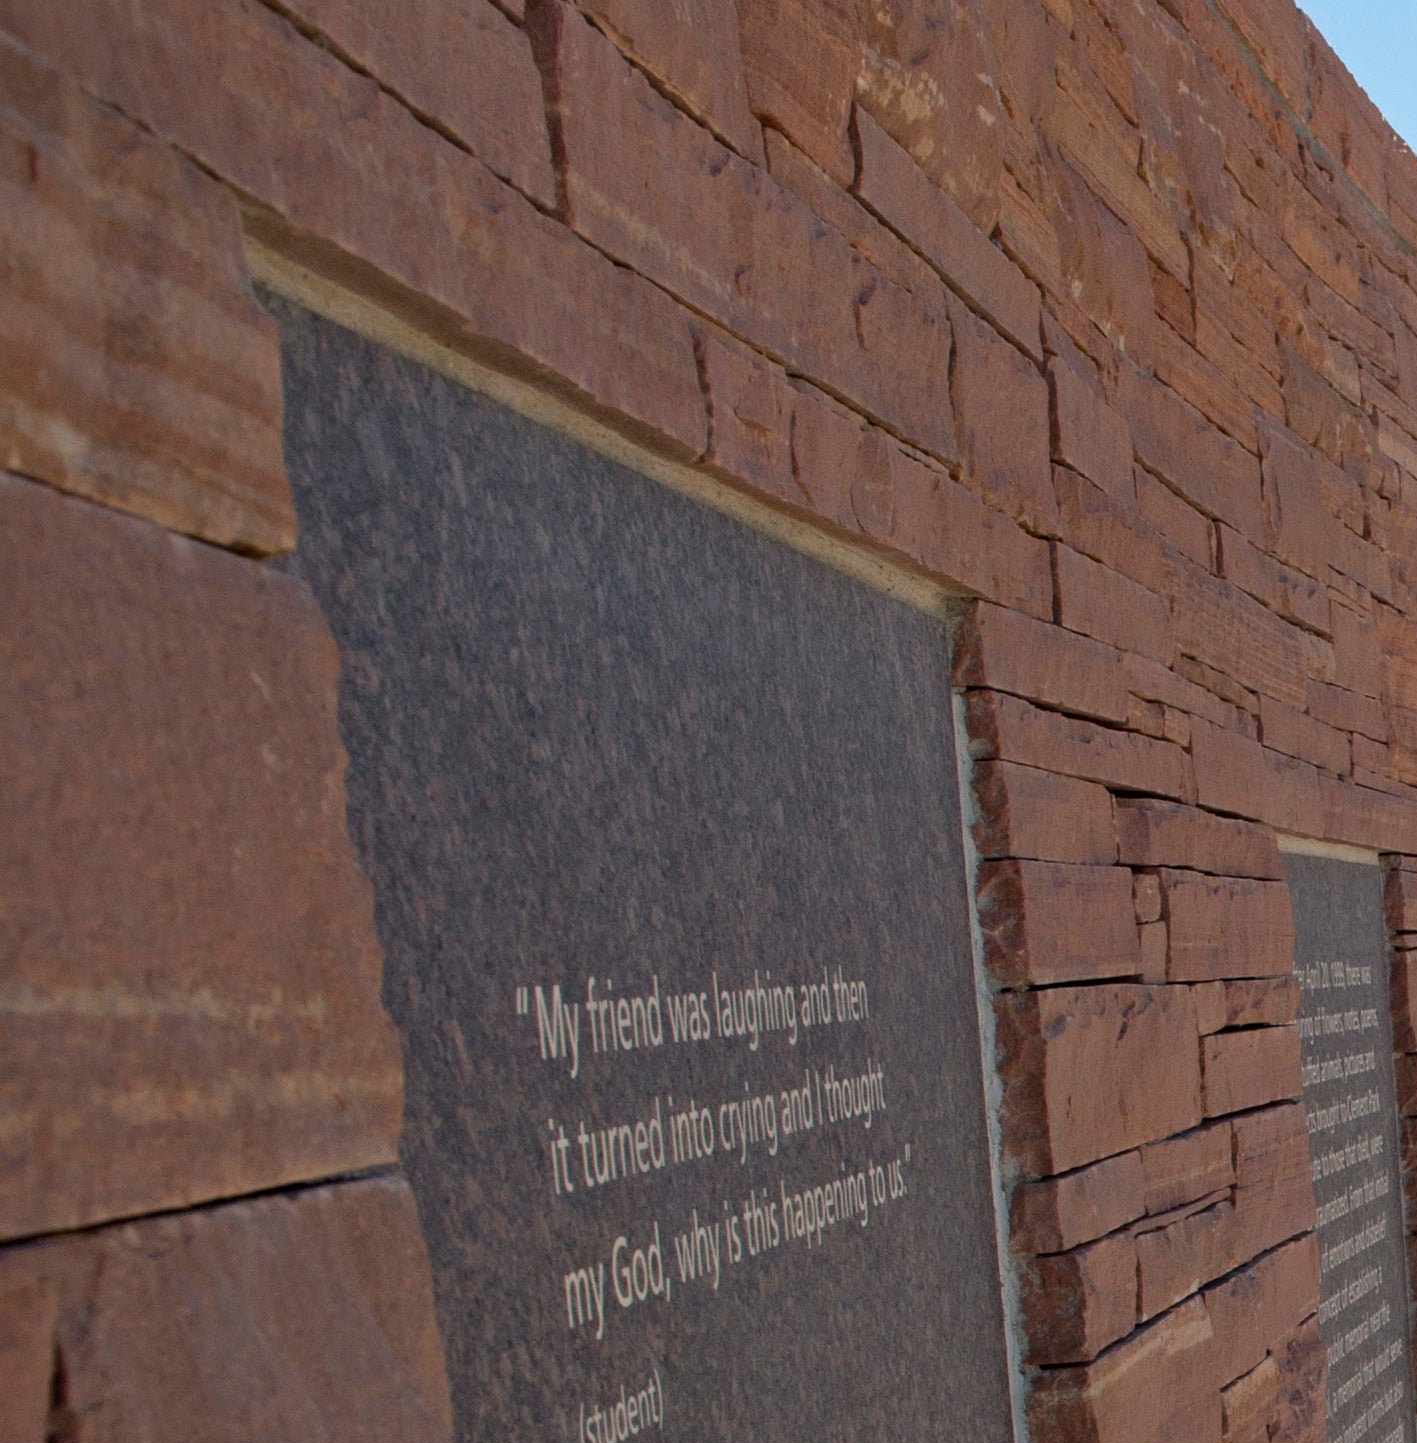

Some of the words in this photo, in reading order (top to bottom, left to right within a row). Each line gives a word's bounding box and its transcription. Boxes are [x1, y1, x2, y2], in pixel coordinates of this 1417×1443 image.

[516, 984, 579, 1079] "My
[586, 975, 663, 1053] friend
[667, 992, 710, 1043] was
[713, 969, 798, 1051] laughing
[801, 966, 831, 1027] and
[832, 965, 870, 1022] then
[549, 1118, 574, 1196] it
[578, 1097, 665, 1188] turned
[669, 1096, 714, 1163] into
[720, 1081, 778, 1164] crying
[781, 1068, 813, 1135] and
[815, 1070, 823, 1125] I
[825, 1057, 886, 1128] thought
[565, 1263, 604, 1339] my
[612, 1221, 671, 1307] God,
[674, 1208, 719, 1290] why
[724, 1200, 741, 1264] is
[744, 1188, 779, 1256] this
[780, 1162, 868, 1249] happening
[869, 1160, 885, 1207] to
[888, 1144, 911, 1199] us."
